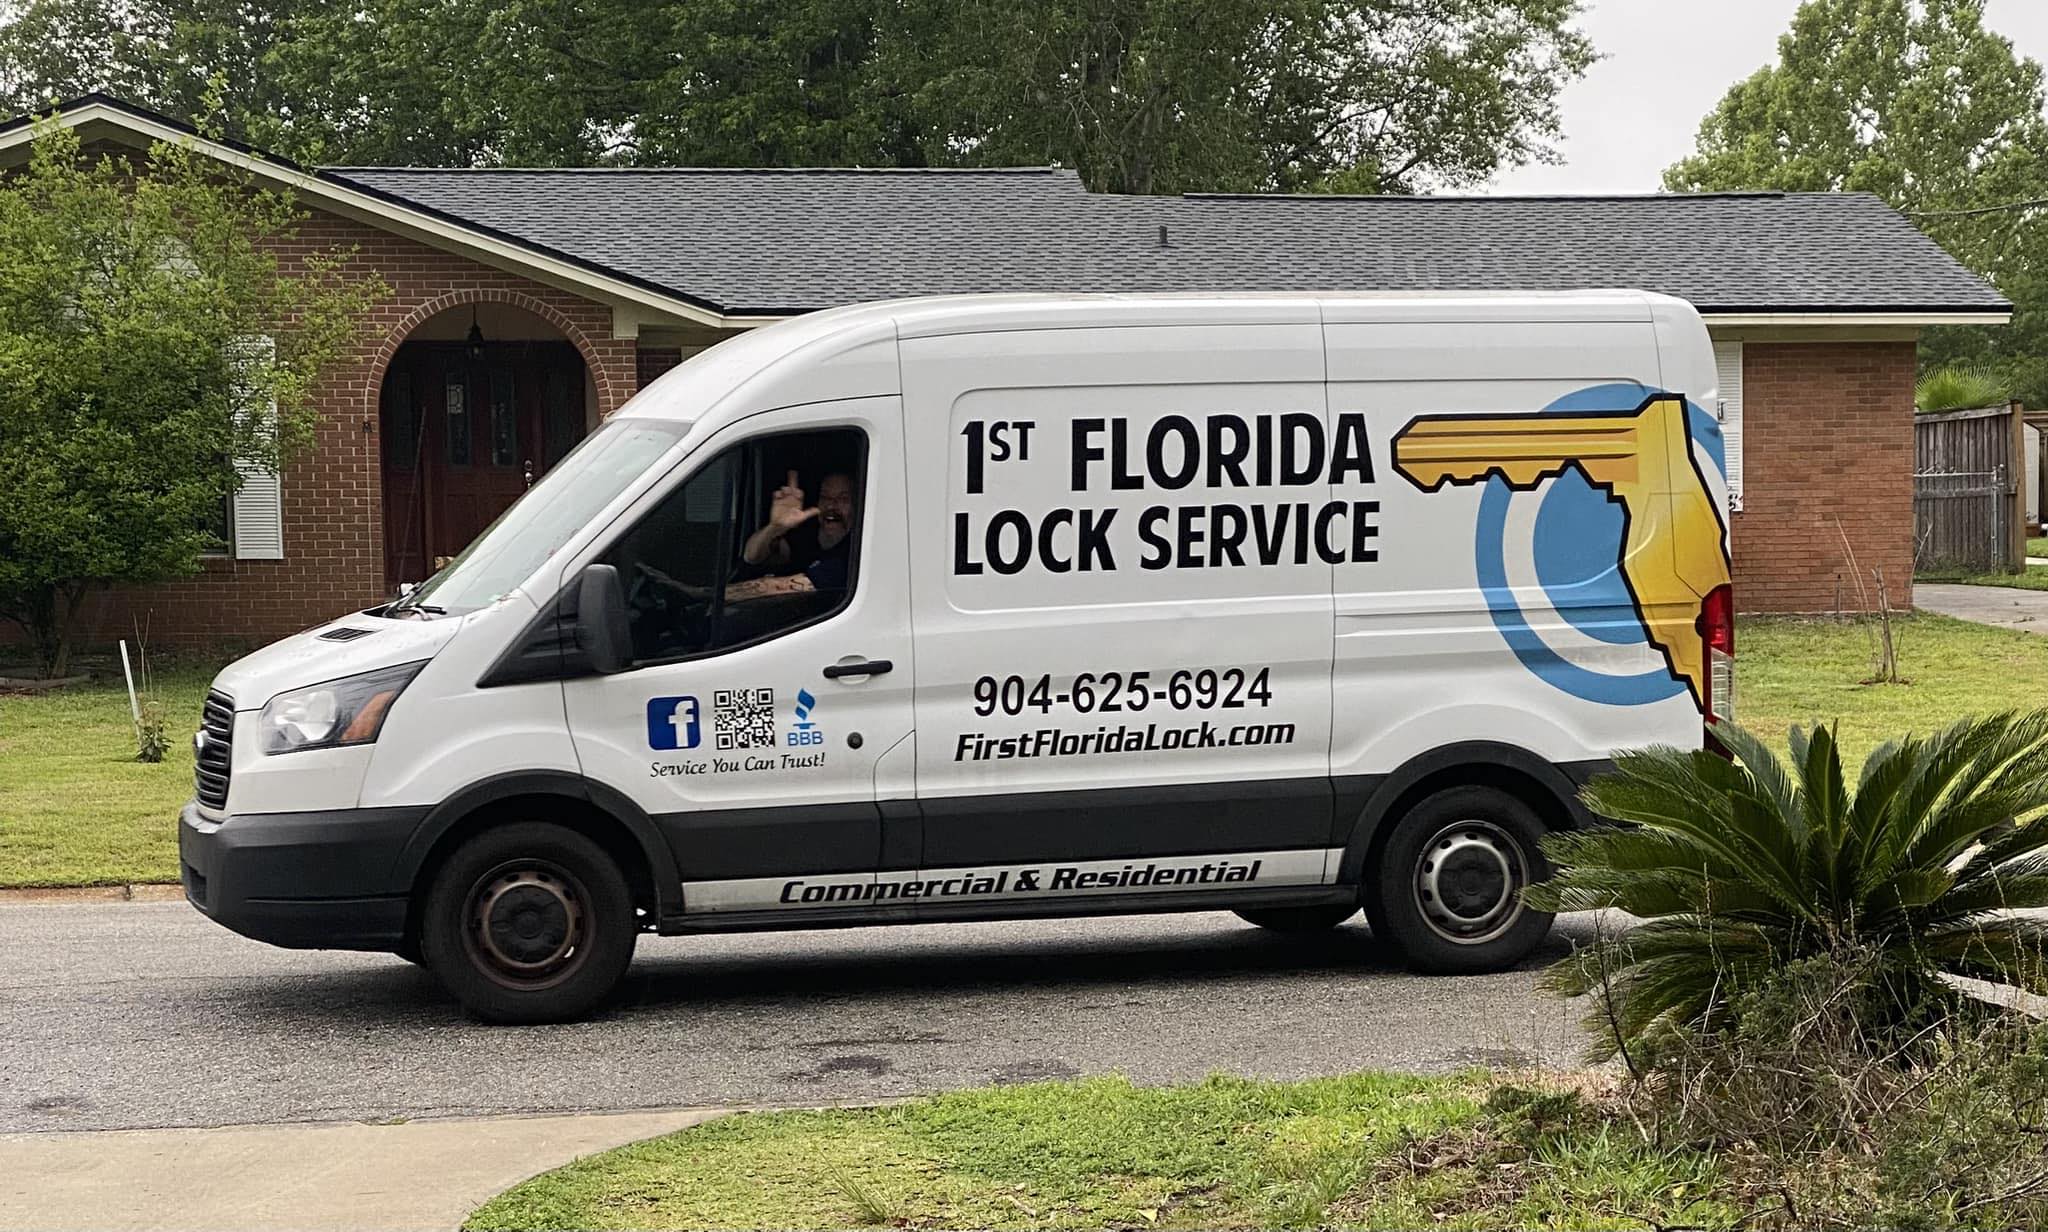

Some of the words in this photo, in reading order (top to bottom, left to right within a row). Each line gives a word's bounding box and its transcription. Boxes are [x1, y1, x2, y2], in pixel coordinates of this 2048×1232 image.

[960, 419, 1036, 494] 1ST
[1071, 412, 1376, 492] FLORIDA
[954, 507, 1119, 575] LOCK
[1138, 500, 1380, 570] SERVICE
[973, 667, 1273, 717] 904-625-6924
[787, 731, 823, 746] BBB
[954, 720, 1296, 762] FirstFloridaLock.com
[650, 760, 707, 778] Service
[713, 757, 739, 773] You
[744, 755, 775, 771] Can
[781, 752, 825, 769] Trust!
[778, 871, 1009, 904] Commercial
[1013, 869, 1041, 892] &
[1049, 860, 1262, 890] Residential
